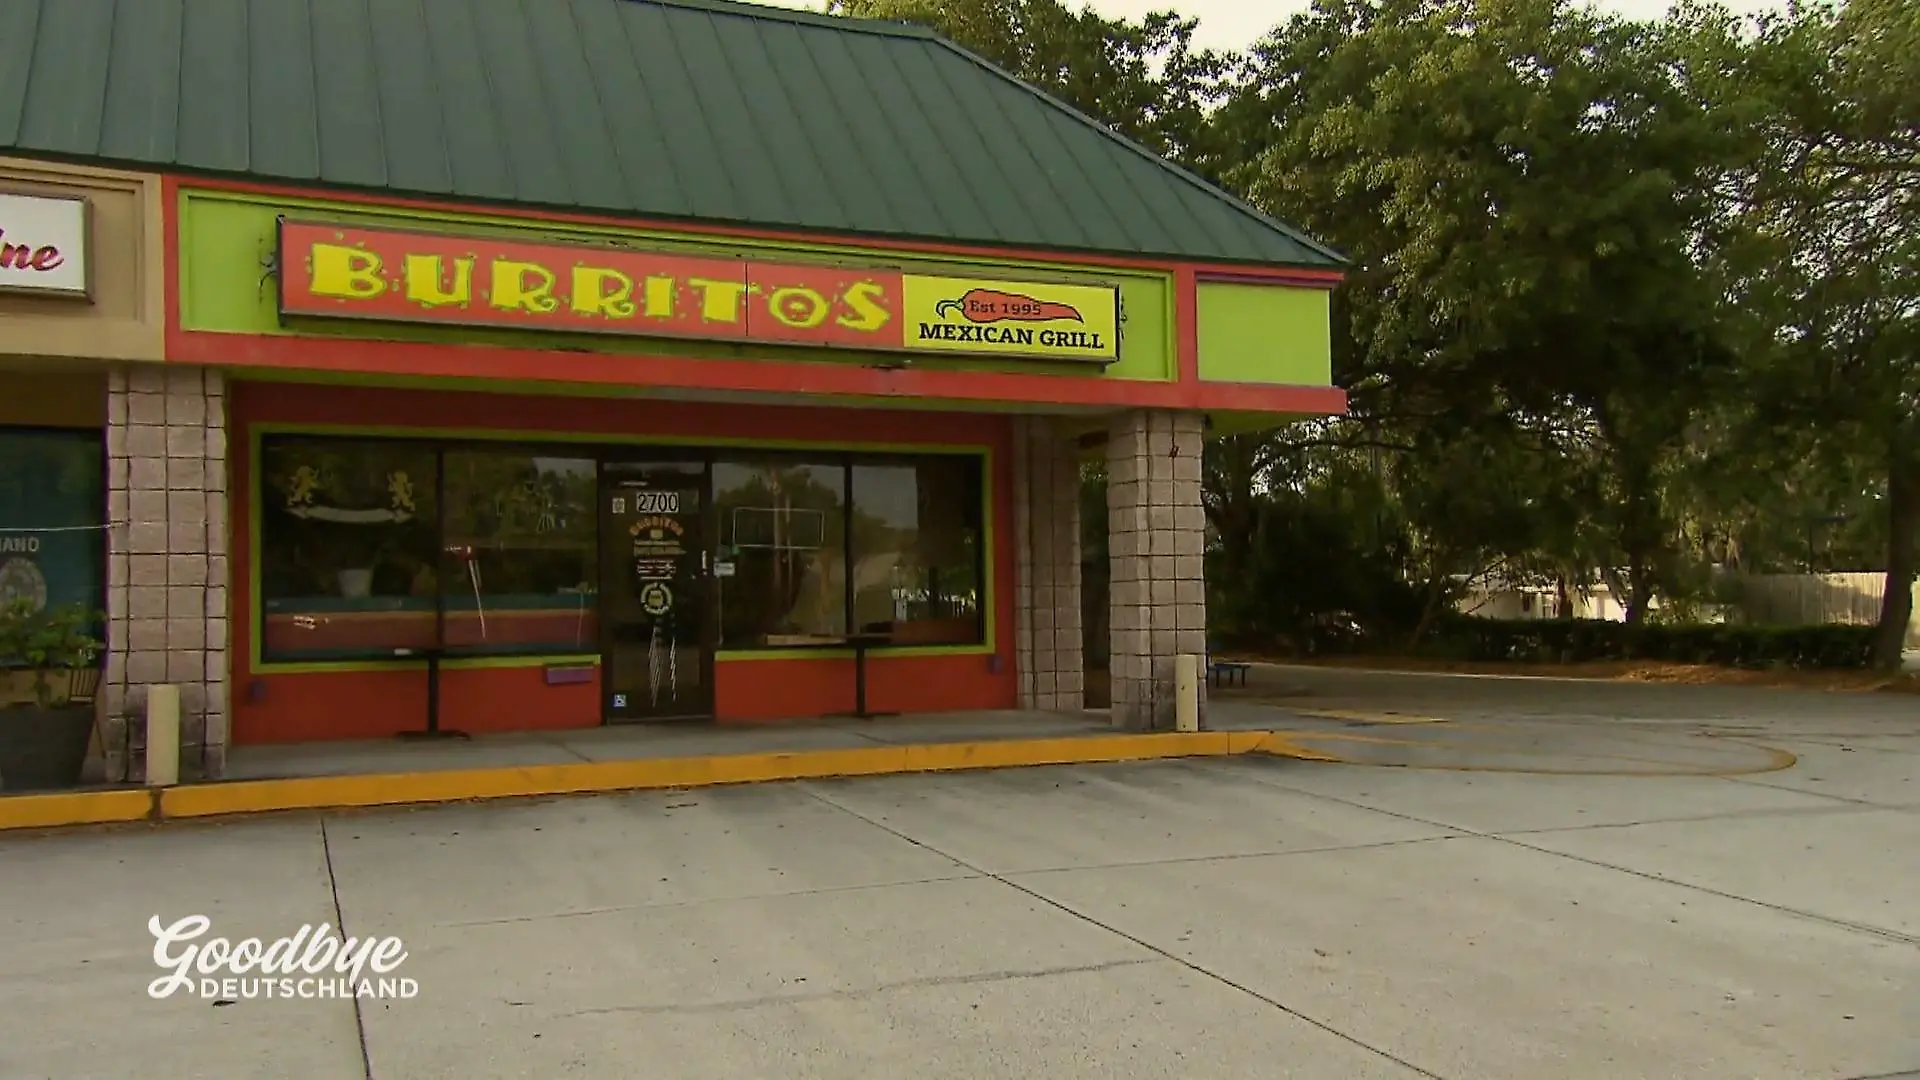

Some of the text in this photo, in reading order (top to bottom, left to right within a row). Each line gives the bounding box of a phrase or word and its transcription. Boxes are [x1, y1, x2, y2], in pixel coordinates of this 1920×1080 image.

[0, 232, 64, 271] ne
[309, 242, 892, 331] BURRITOS
[968, 299, 1042, 316] Est 1995
[918, 322, 1105, 349] MEXICAN GRILL
[637, 493, 679, 512] 2700
